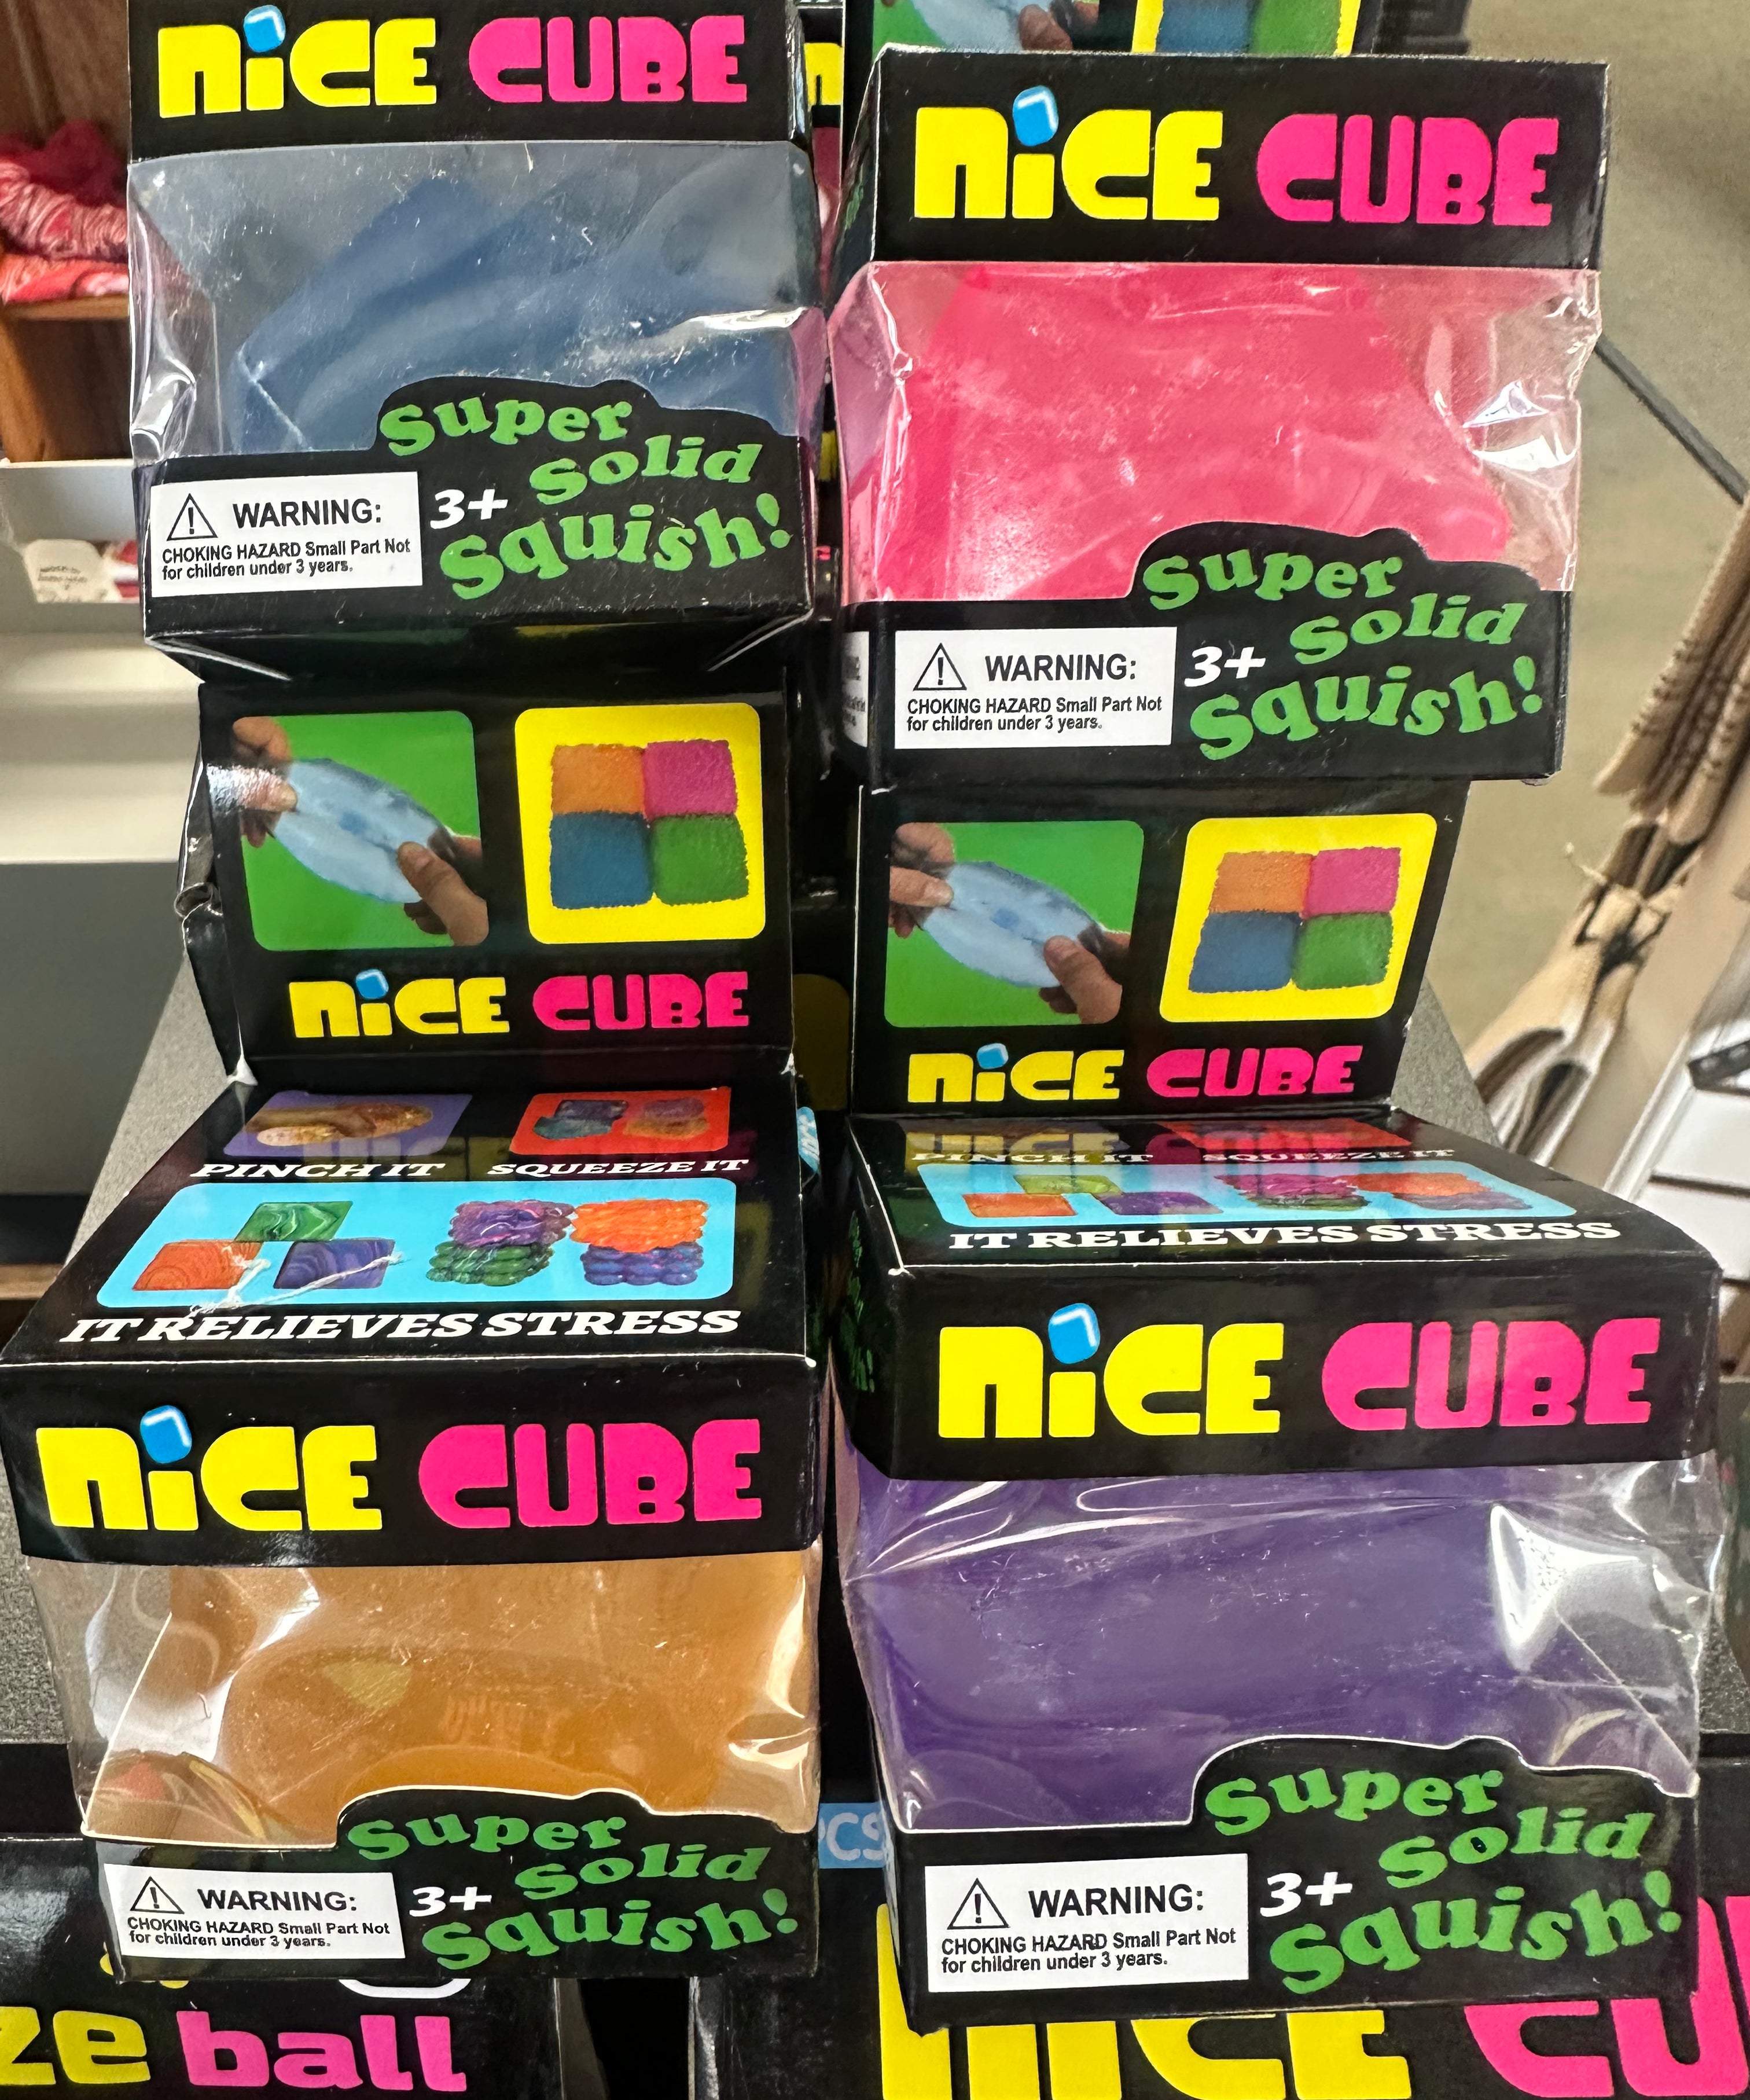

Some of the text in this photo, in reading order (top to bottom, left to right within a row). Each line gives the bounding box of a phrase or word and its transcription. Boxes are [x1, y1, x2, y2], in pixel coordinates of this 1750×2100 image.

[469, 16, 747, 103] CUBE
[1256, 113, 1559, 226] CUBE
[380, 397, 633, 456] Super
[233, 498, 381, 528] WARNING:
[429, 489, 509, 530] 3+
[163, 538, 410, 563] CHOKING HAZARD Small Part Not
[440, 493, 792, 600] Squish!
[163, 559, 353, 580] for children under 3 years.
[1143, 549, 1403, 610] Super
[985, 654, 1136, 681] WARNING:
[1183, 647, 1266, 687] 3+
[907, 696, 1161, 714] CHOKING HAZARD Small Part Not
[1190, 655, 1543, 760] Squish!
[907, 715, 1102, 733] for children under 3 years.
[532, 971, 749, 1031] CUBE
[1147, 1045, 1362, 1097] CUBE
[190, 1163, 446, 1177] PINCH IT
[487, 1159, 749, 1177] SQUEEZE IT
[912, 1153, 1089, 1162] PINCH
[1203, 1151, 1405, 1162] SQUEEZE
[948, 1222, 1621, 1249] IT RELIEVES STRESS
[58, 1310, 742, 1342] IT RELIEVES STRESS
[1322, 1317, 1661, 1431] CUBE
[418, 1419, 762, 1529] CUBE
[1205, 1768, 1503, 1835] Super
[347, 1813, 627, 1860] Super
[818, 1812, 884, 1861] CS
[197, 1889, 357, 1911] WARNING:
[409, 1886, 493, 1918] 3+
[1028, 1884, 1203, 1918] WARNING:
[1260, 1871, 1353, 1918] 3+
[127, 1916, 390, 1934] CHOKING HAZARD Small Part Not
[129, 1930, 331, 1949] for children under 3 years.
[422, 1888, 799, 1970] Squish!
[942, 1928, 1236, 1955] CHOKING HAZARD Small Part Not
[1270, 1871, 1682, 1994] Squish!
[942, 1952, 1168, 1973] for children under 3 years.
[177, 2010, 466, 2091] ball
